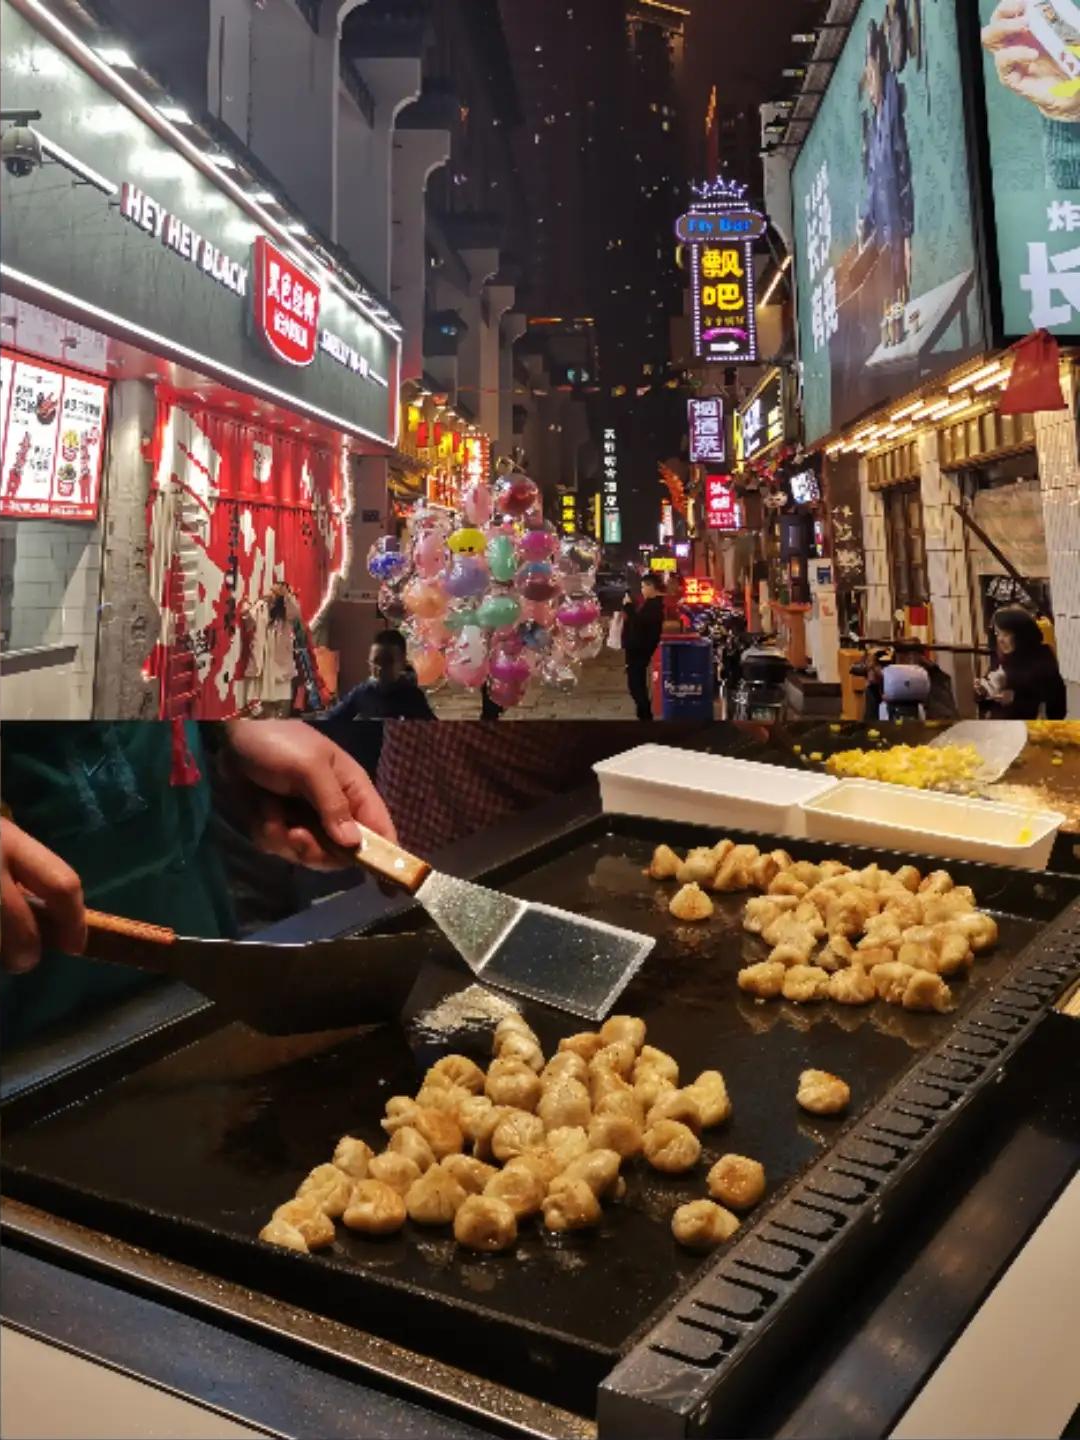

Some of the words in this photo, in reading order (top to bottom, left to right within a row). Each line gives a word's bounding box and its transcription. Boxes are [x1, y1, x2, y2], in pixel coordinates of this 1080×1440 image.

[122, 182, 167, 238] HEY
[167, 214, 203, 264] HEY
[201, 242, 249, 298] BLACK
[701, 249, 744, 311] 飘吧
